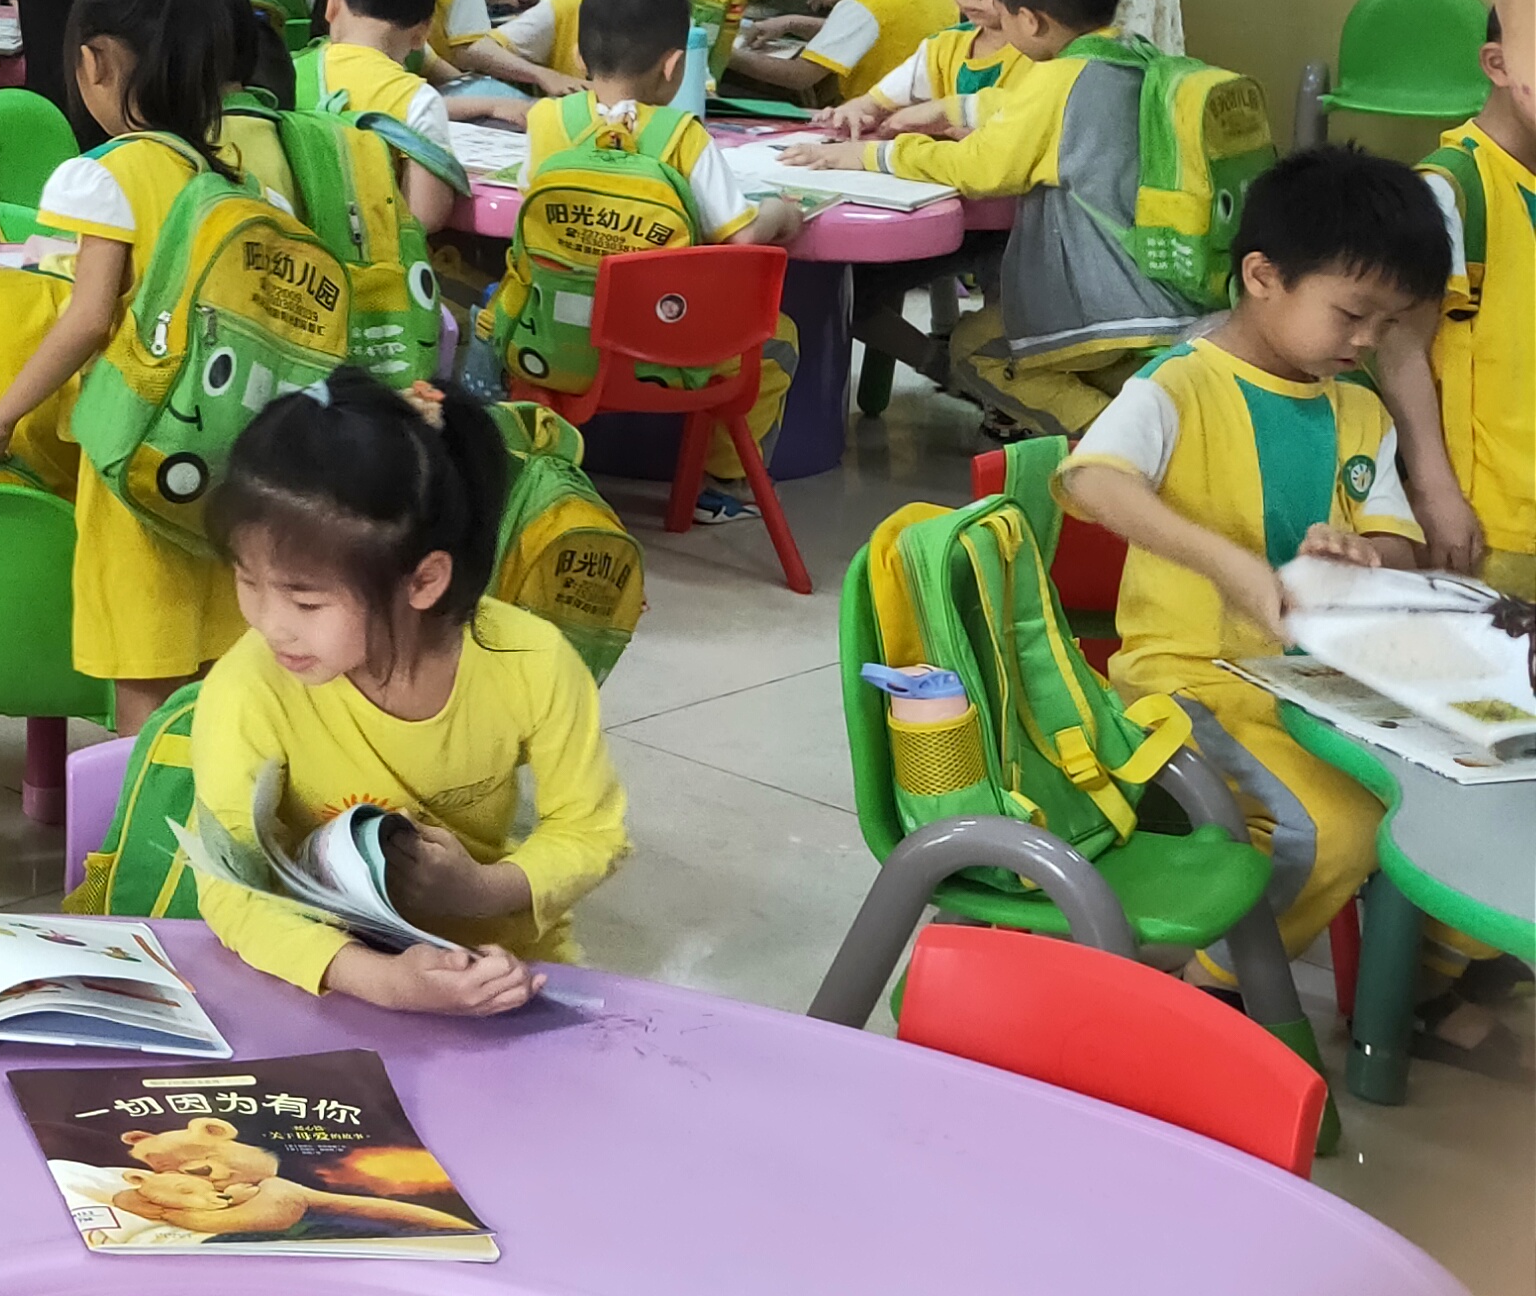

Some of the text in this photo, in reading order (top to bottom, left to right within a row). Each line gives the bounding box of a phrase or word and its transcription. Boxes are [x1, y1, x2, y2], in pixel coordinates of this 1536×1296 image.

[545, 202, 675, 246] 阳光幼儿园
[74, 1091, 362, 1125] 一切因为有你
